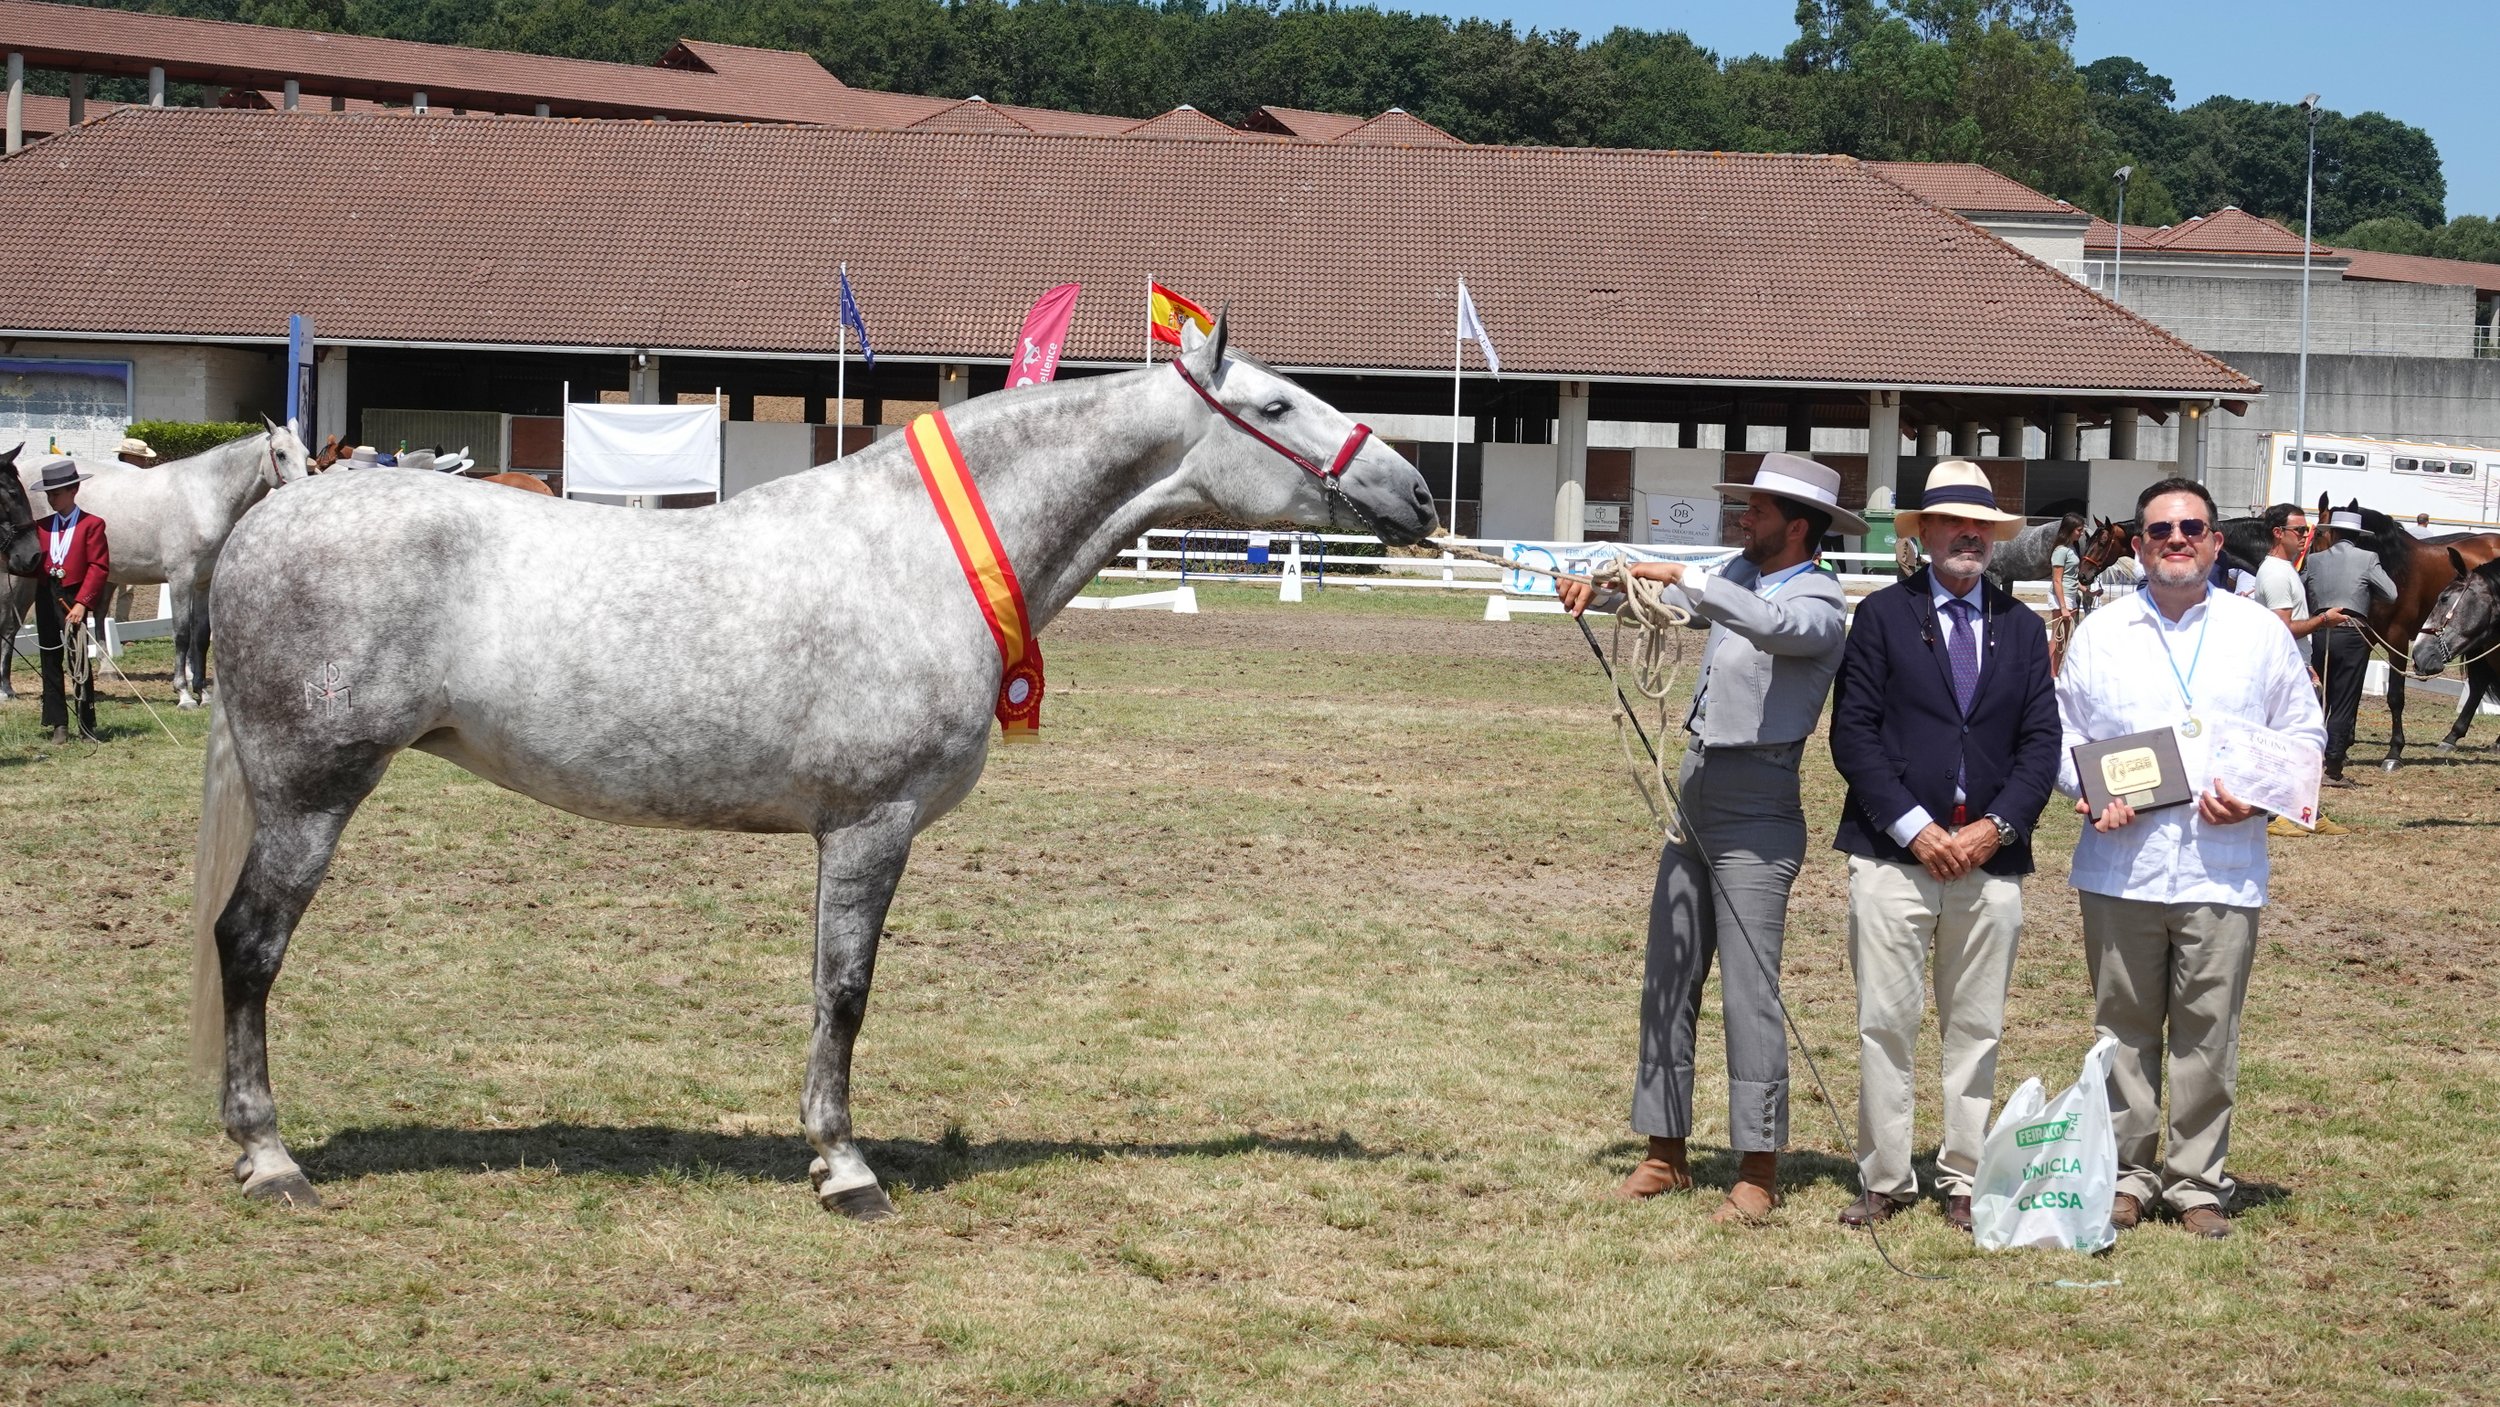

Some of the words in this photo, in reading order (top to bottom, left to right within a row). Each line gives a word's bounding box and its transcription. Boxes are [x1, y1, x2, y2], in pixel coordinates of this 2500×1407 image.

[1040, 342, 1058, 383] ellence
[1674, 508, 1689, 518] DB
[1287, 564, 1297, 575] A
[2019, 1124, 2063, 1145] FEIRACO
[2022, 1158, 2082, 1181] ÚNICLA
